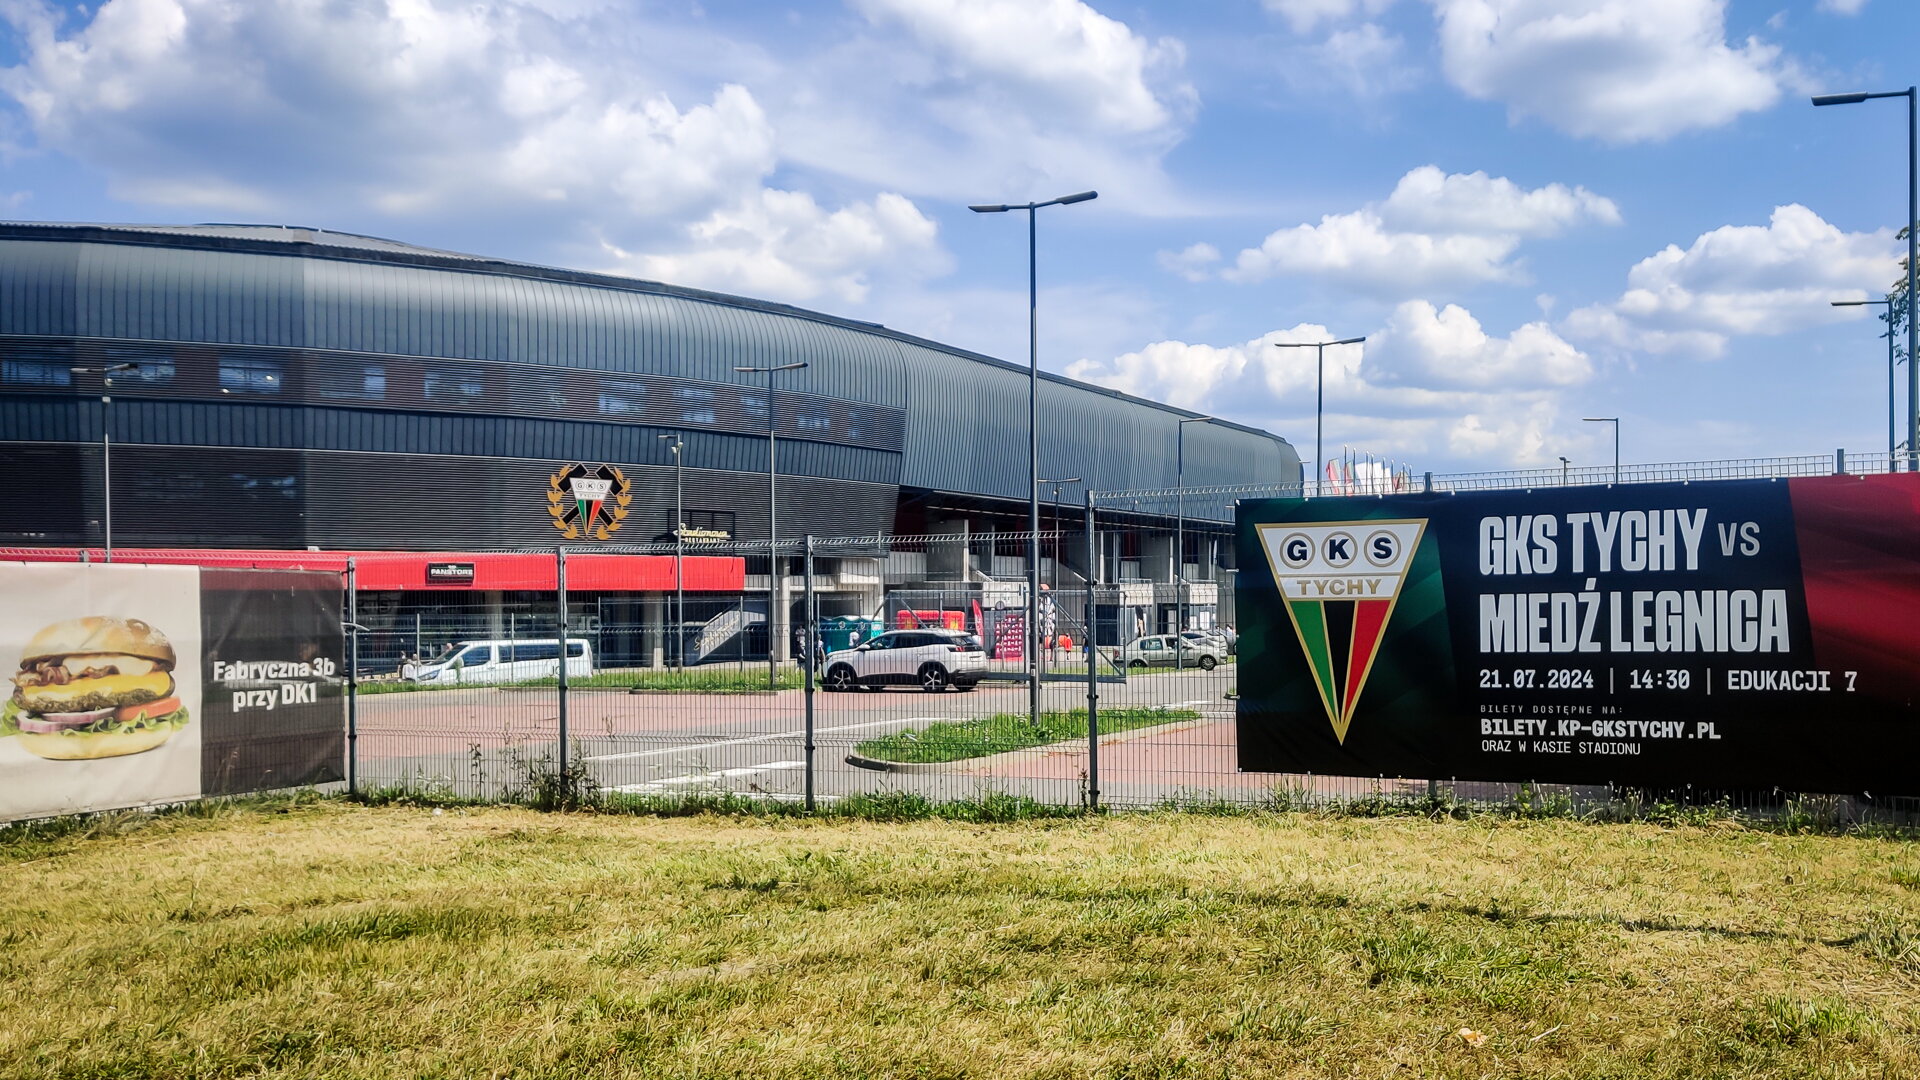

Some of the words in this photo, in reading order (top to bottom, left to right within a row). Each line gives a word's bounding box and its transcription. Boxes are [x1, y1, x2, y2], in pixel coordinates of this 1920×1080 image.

[1286, 536, 1393, 562] GKS
[1479, 514, 1557, 575] GKS
[1567, 508, 1708, 572] TYCHY
[1717, 521, 1761, 557] VS
[1296, 579, 1382, 596] TYCHY
[1479, 577, 1602, 653] MIEDŹ
[1610, 589, 1790, 653] LEGNICA
[213, 660, 310, 683] Fabryczna
[312, 657, 335, 677] 3b
[1479, 668, 1594, 689] 21.07.2024
[1629, 669, 1690, 690] 14:30
[1727, 670, 1830, 692] EDUKACJI
[1844, 670, 1858, 692] 7
[233, 689, 279, 712] przy
[282, 682, 318, 705] DK1
[1480, 704, 1524, 713] BILETY
[1532, 705, 1593, 715] DOSTĘPNE
[1602, 706, 1623, 714] NA:
[1480, 718, 1722, 740] BILETY.KP-GKSTYCHY.PL
[1481, 739, 1512, 752] ORAZ
[1518, 740, 1527, 753] W
[1533, 740, 1572, 754] KASIE
[1578, 741, 1641, 755] STADIONU
